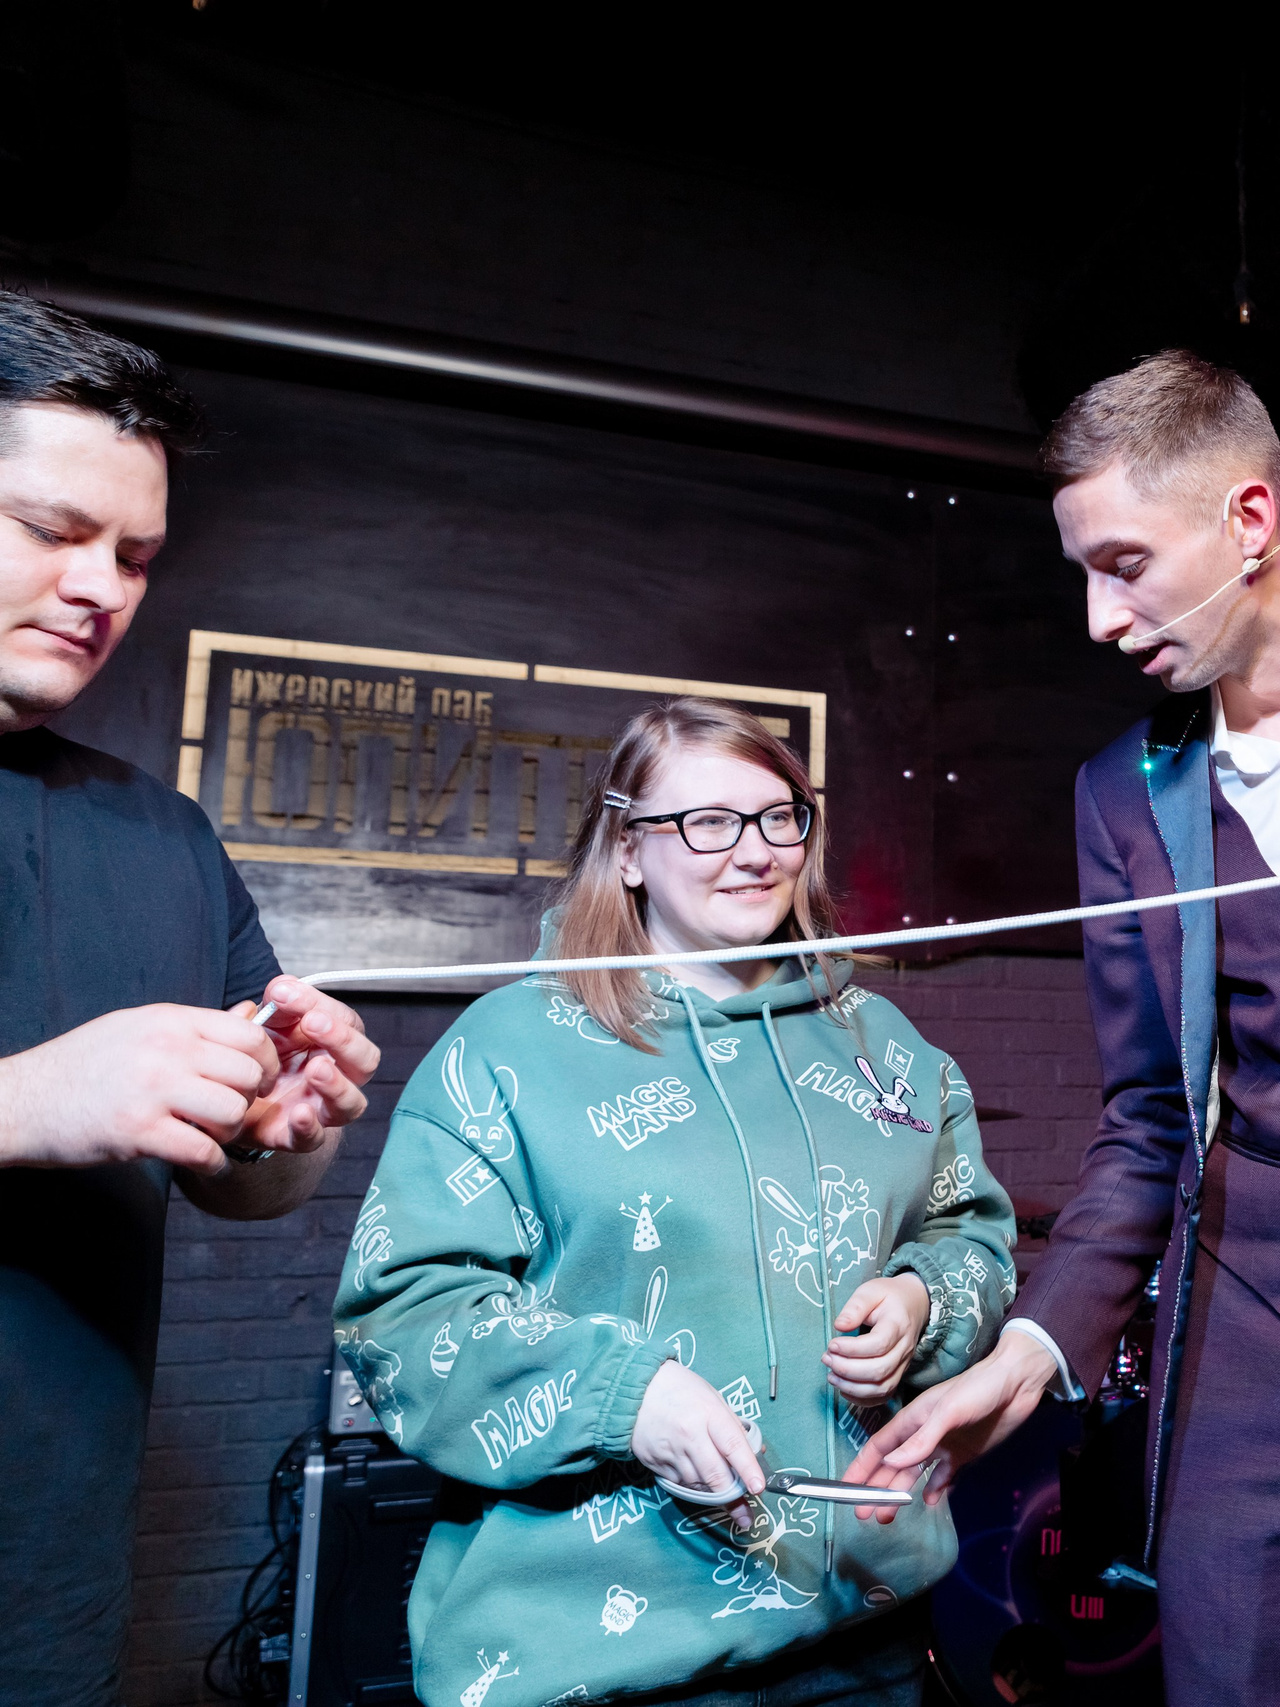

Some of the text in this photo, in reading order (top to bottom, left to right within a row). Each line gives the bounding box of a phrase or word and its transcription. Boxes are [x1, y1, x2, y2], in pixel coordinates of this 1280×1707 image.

[586, 1076, 691, 1138] MAGIC
[612, 1097, 697, 1151] LAND
[471, 1369, 577, 1471] MAGIC
[587, 1484, 673, 1544] LAN
[604, 1609, 625, 1626] LAND
[607, 1601, 635, 1622] MAGIC
